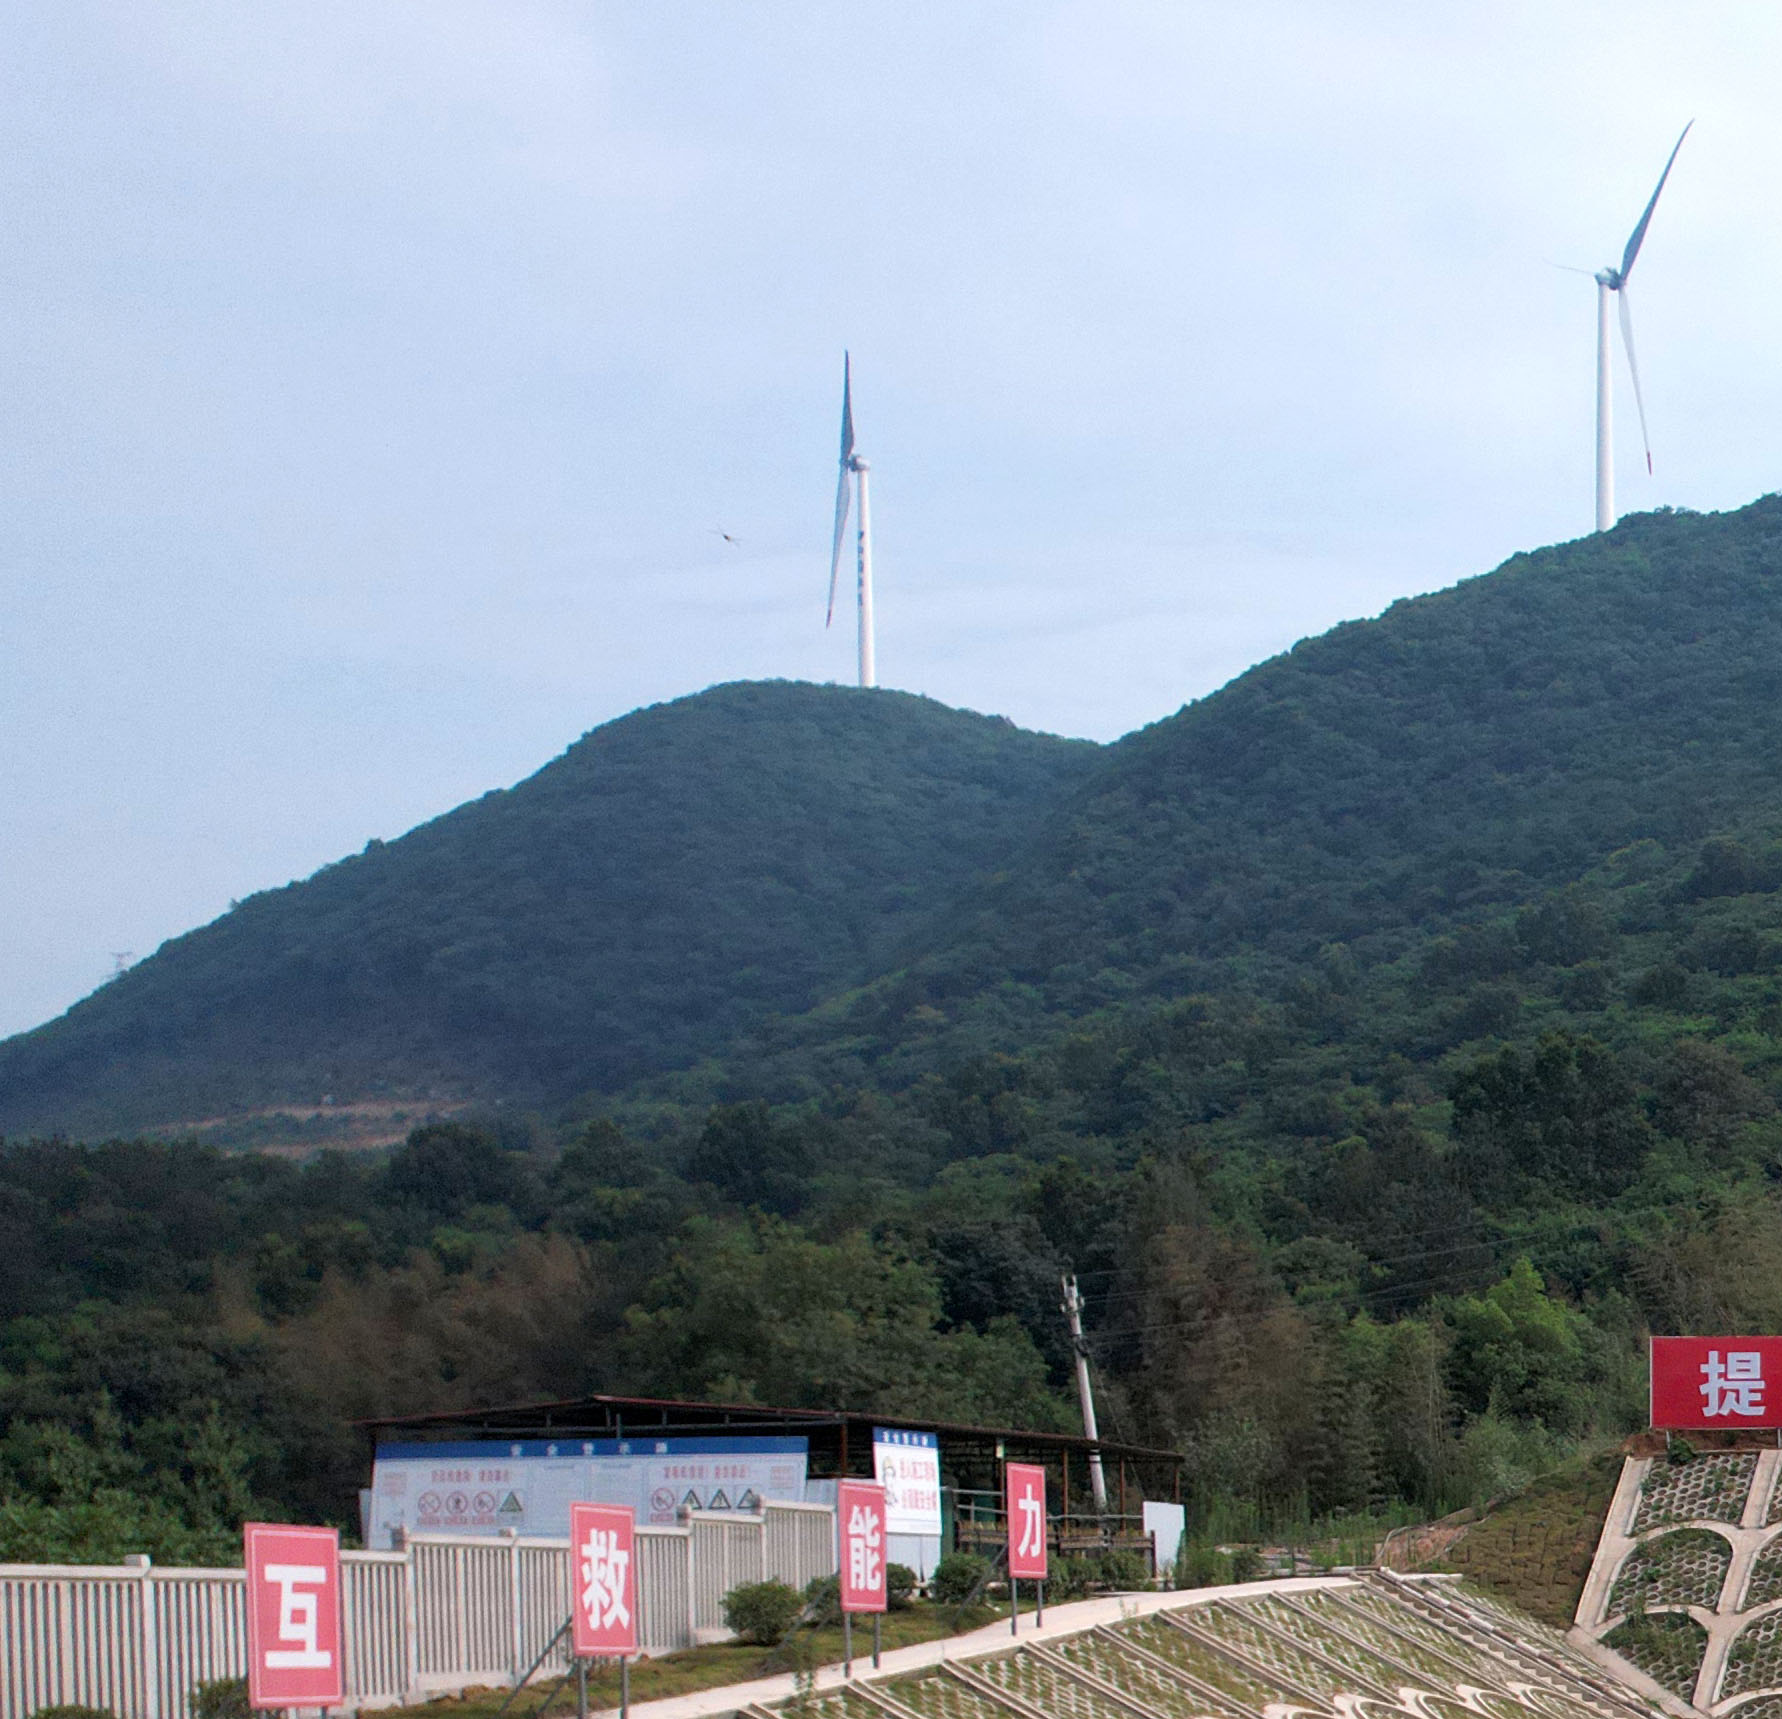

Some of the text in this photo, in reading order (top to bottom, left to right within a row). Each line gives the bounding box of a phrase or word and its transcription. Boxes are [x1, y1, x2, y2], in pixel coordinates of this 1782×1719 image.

[847, 1505, 882, 1596] 能
[1018, 1484, 1042, 1558] 力
[263, 1564, 332, 1669] 互
[580, 1530, 631, 1631] 救
